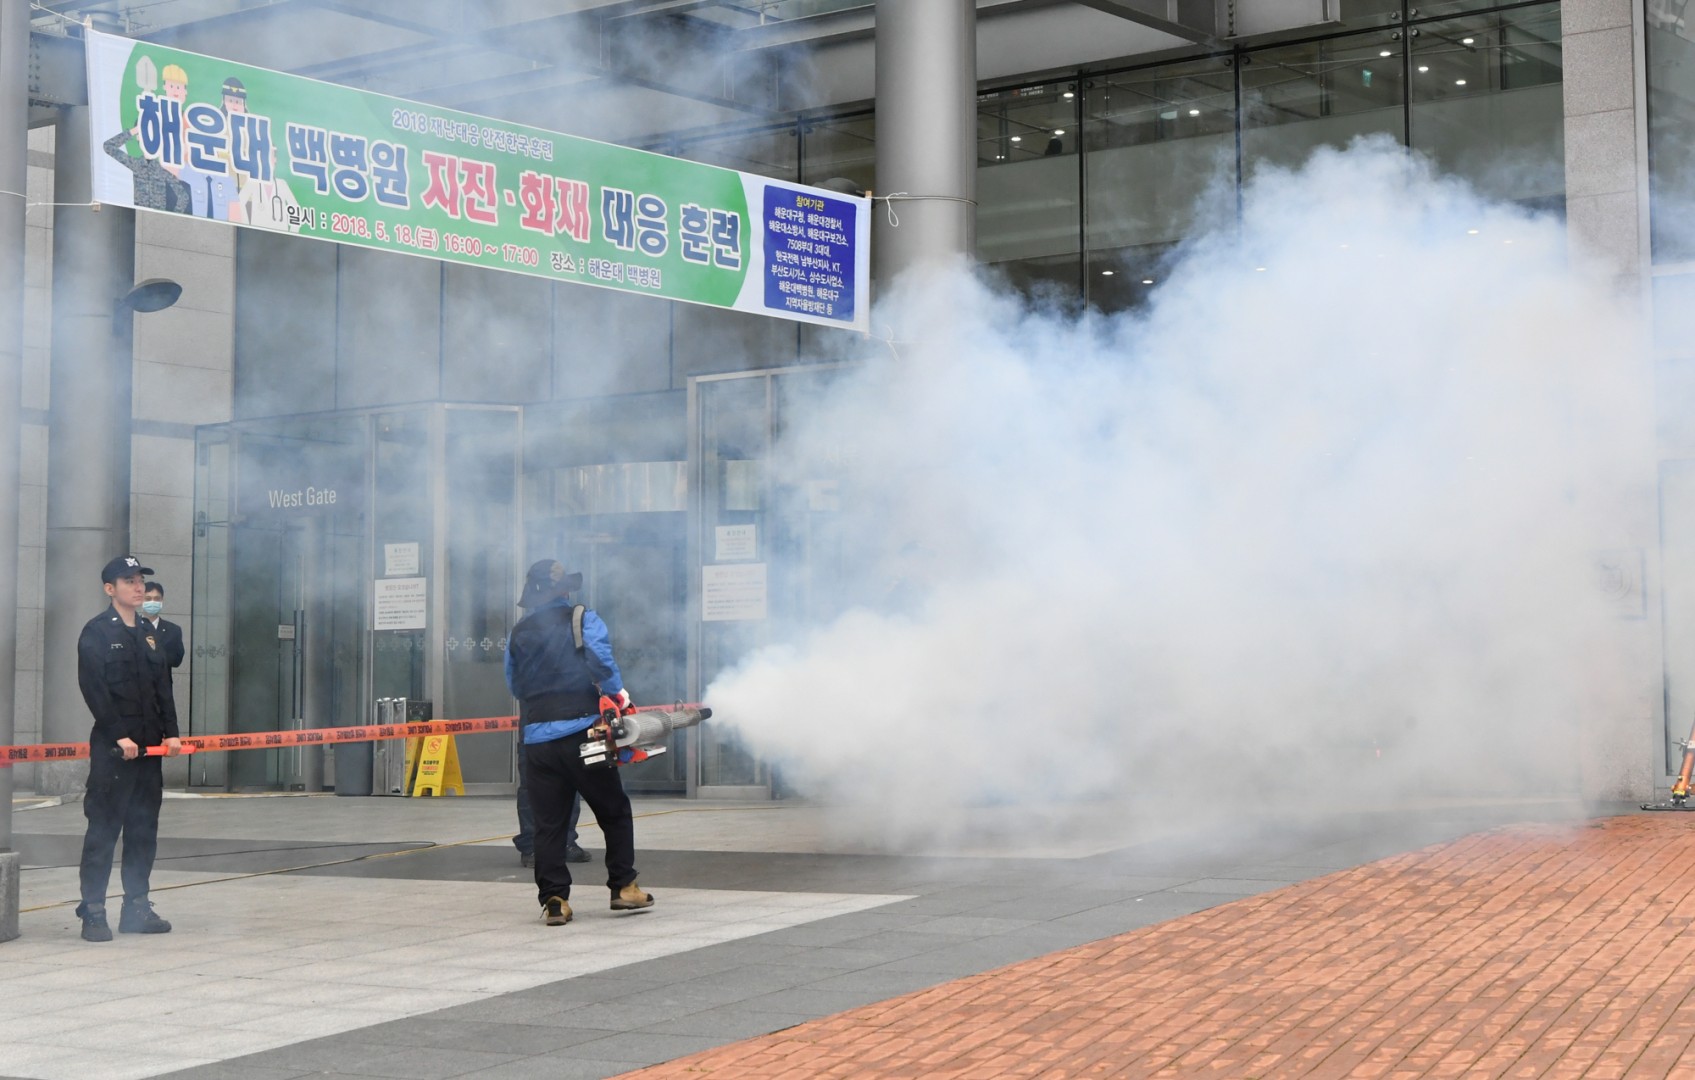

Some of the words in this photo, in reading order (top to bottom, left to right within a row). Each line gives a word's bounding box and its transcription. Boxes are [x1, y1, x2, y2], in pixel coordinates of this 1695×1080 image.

[393, 109, 427, 132] 2018
[431, 116, 480, 146] 재난대응
[482, 130, 553, 161] 안전한국훈련
[138, 95, 272, 181] 해운대
[288, 123, 410, 208] 백병원
[602, 186, 668, 257] 대응
[680, 203, 742, 271] 훈련
[796, 195, 825, 212] 참여기관
[332, 213, 370, 239] 2018.
[376, 221, 390, 241] 5.
[444, 235, 481, 257] 16:00
[502, 244, 539, 266] 17:00
[551, 252, 576, 273] 장소
[588, 259, 623, 282] 해운대
[627, 266, 662, 288] 백병원
[776, 251, 799, 265] 한국전력
[817, 288, 840, 302] 해운대구
[826, 304, 833, 316] 등
[269, 490, 303, 509] West
[306, 486, 336, 506] Gate
[408, 726, 417, 735] LINE
[418, 725, 433, 734] POLICE
[296, 734, 306, 743] LINE
[307, 733, 323, 742] POLICE
[45, 748, 56, 758] LINE
[58, 747, 76, 757] POLICE
